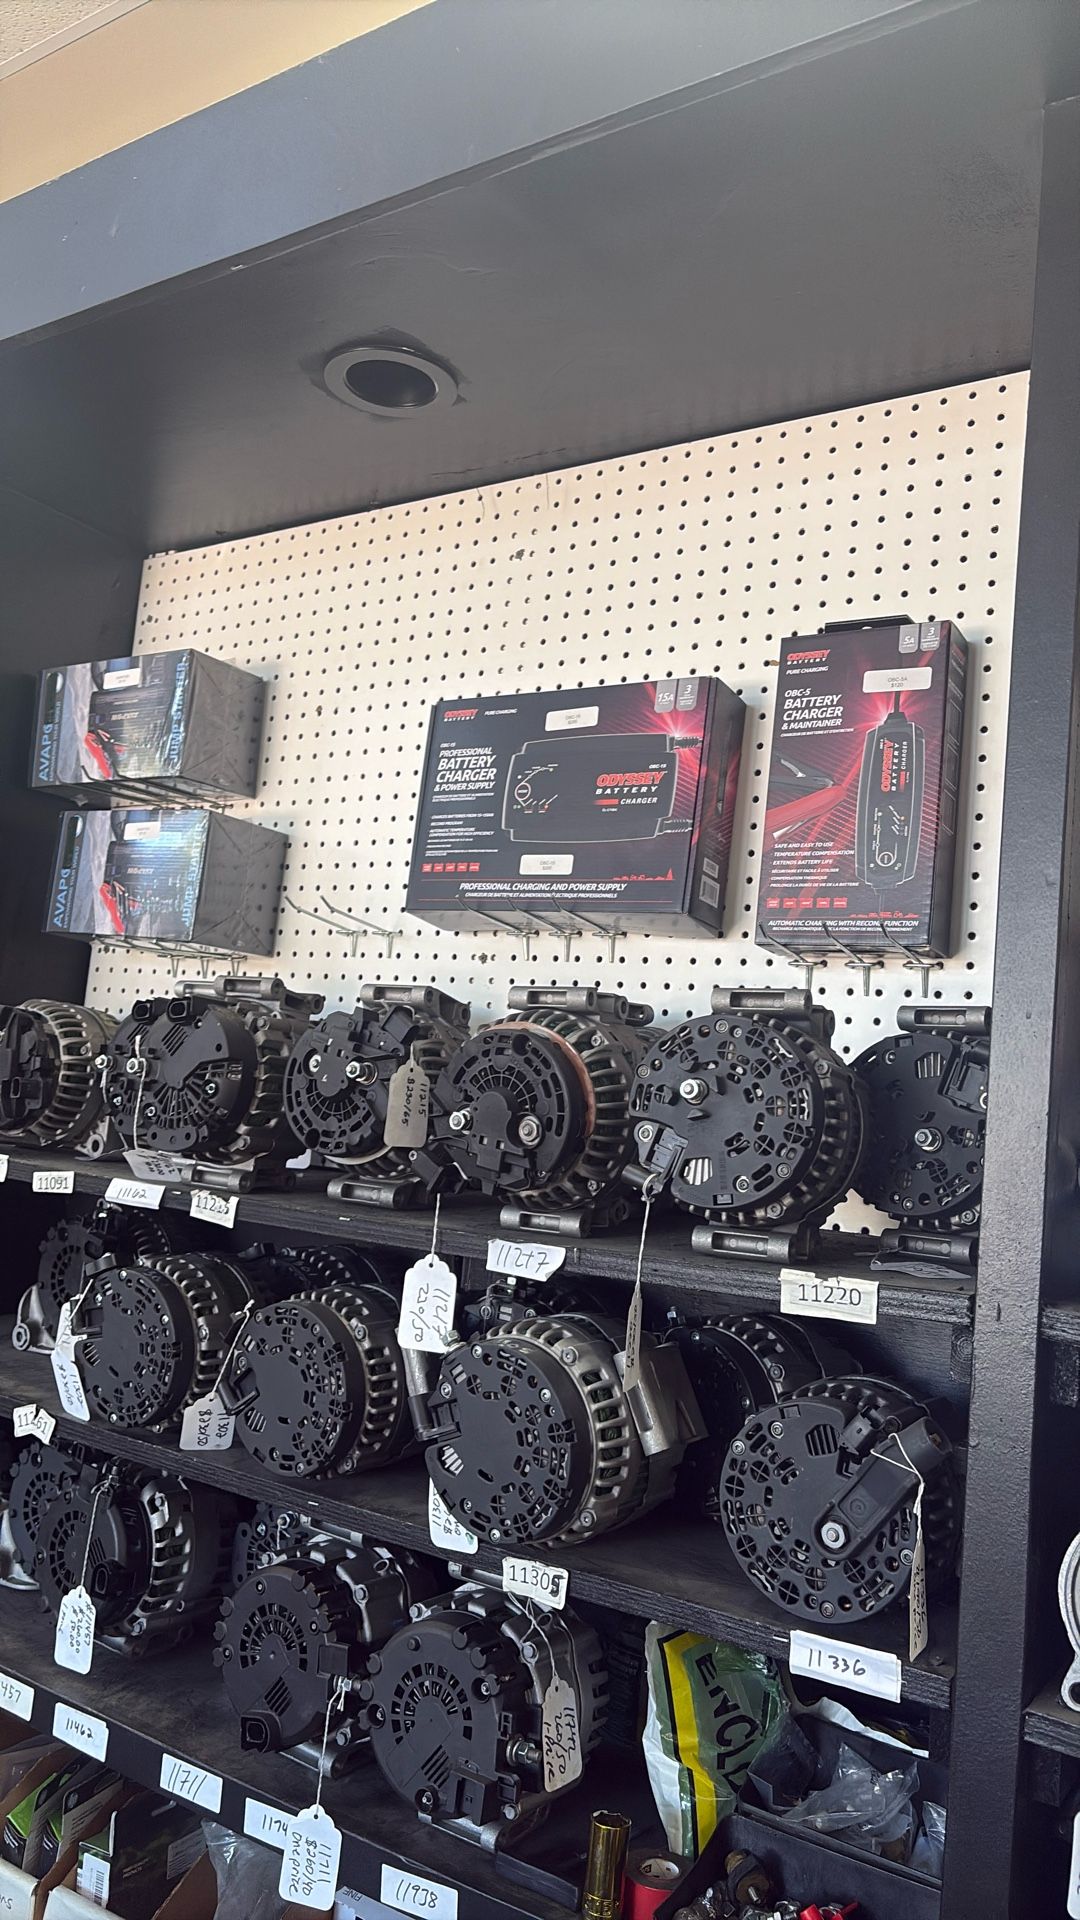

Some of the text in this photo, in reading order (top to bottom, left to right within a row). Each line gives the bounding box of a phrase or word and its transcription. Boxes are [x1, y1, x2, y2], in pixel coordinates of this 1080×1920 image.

[784, 688, 811, 697] OBC-5
[784, 694, 842, 709] BATTERY
[783, 706, 843, 720] CHARGER
[789, 719, 842, 730] MAINTAINER
[170, 724, 182, 762] JUMP
[439, 747, 493, 758] PROFESSIONAL
[438, 755, 496, 770] BATTERY
[881, 738, 894, 792] ODYSSEY
[891, 743, 899, 791] BATTERY
[436, 768, 497, 783] CHARGER
[440, 783, 466, 791] POWER
[466, 781, 496, 790] SUPPLY
[596, 771, 664, 787] ODYSSEY
[596, 786, 658, 794] BATTERY
[181, 886, 194, 927] JUMP
[418, 1083, 427, 1117] 11215
[38, 1177, 69, 1191] 11091
[116, 1188, 147, 1199] 11162
[497, 1245, 549, 1273] 11247
[798, 1284, 861, 1306] 11220
[66, 1717, 94, 1739] 11462
[554, 1712, 568, 1774] 260/50
[168, 1762, 207, 1800] 11711
[292, 1832, 302, 1856] One
[302, 1836, 318, 1896] $260/40
[317, 1844, 332, 1883] 11711
[396, 1879, 439, 1909] 11938
